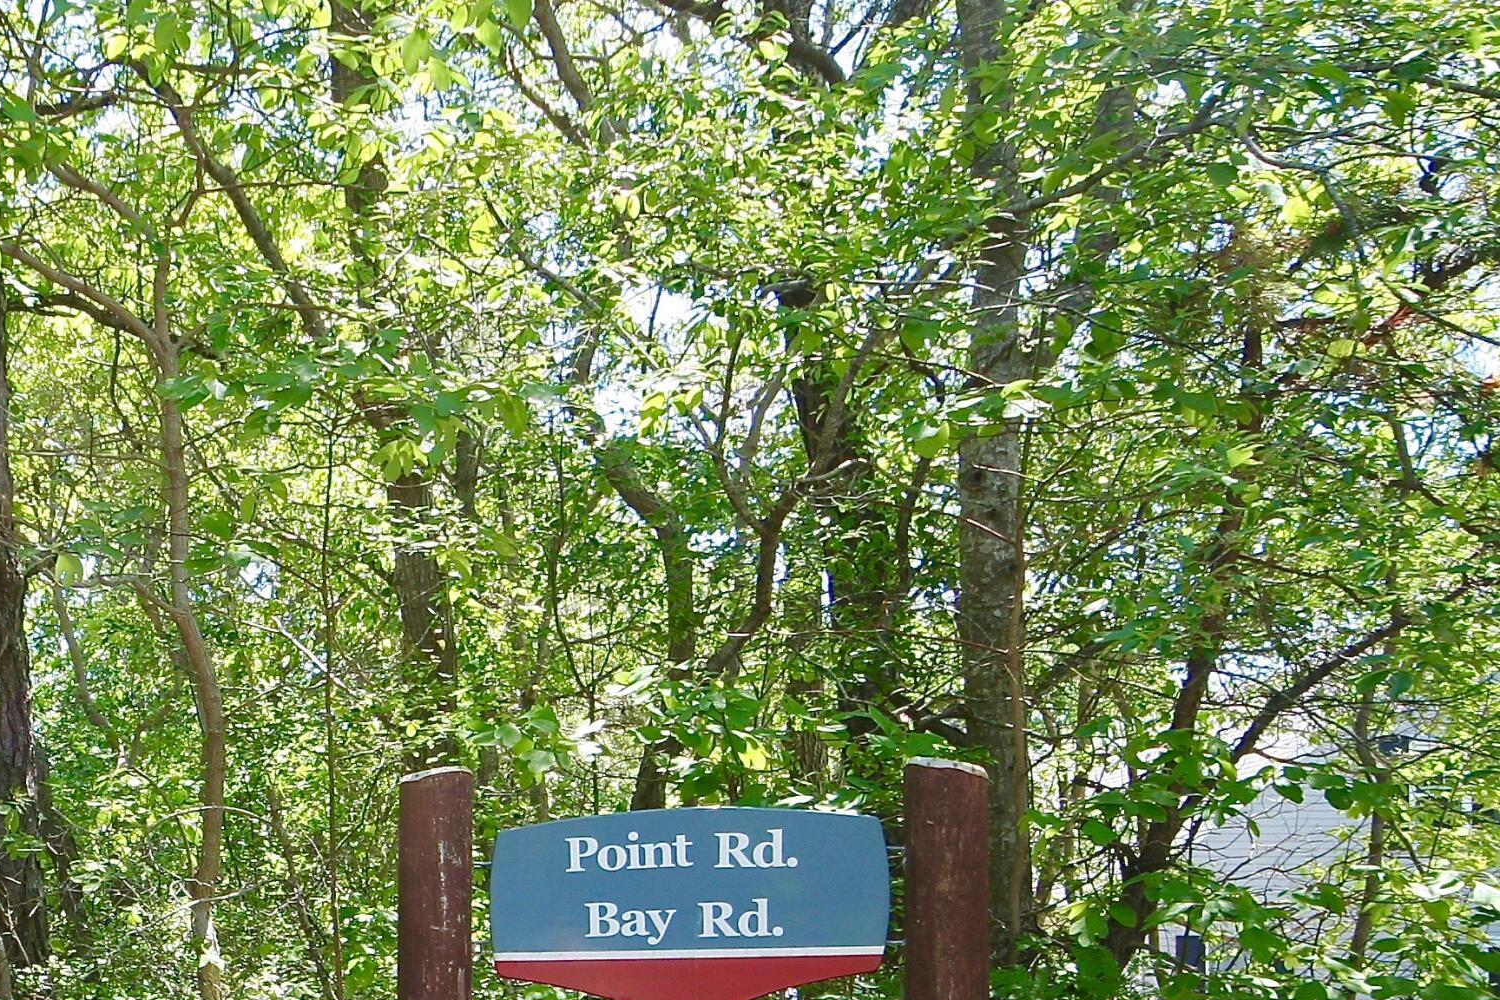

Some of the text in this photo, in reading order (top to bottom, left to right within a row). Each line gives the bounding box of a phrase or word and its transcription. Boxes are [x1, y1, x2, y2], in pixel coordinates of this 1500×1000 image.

[564, 828, 798, 873] Point Rd.
[584, 898, 784, 945] Bay Rd.
